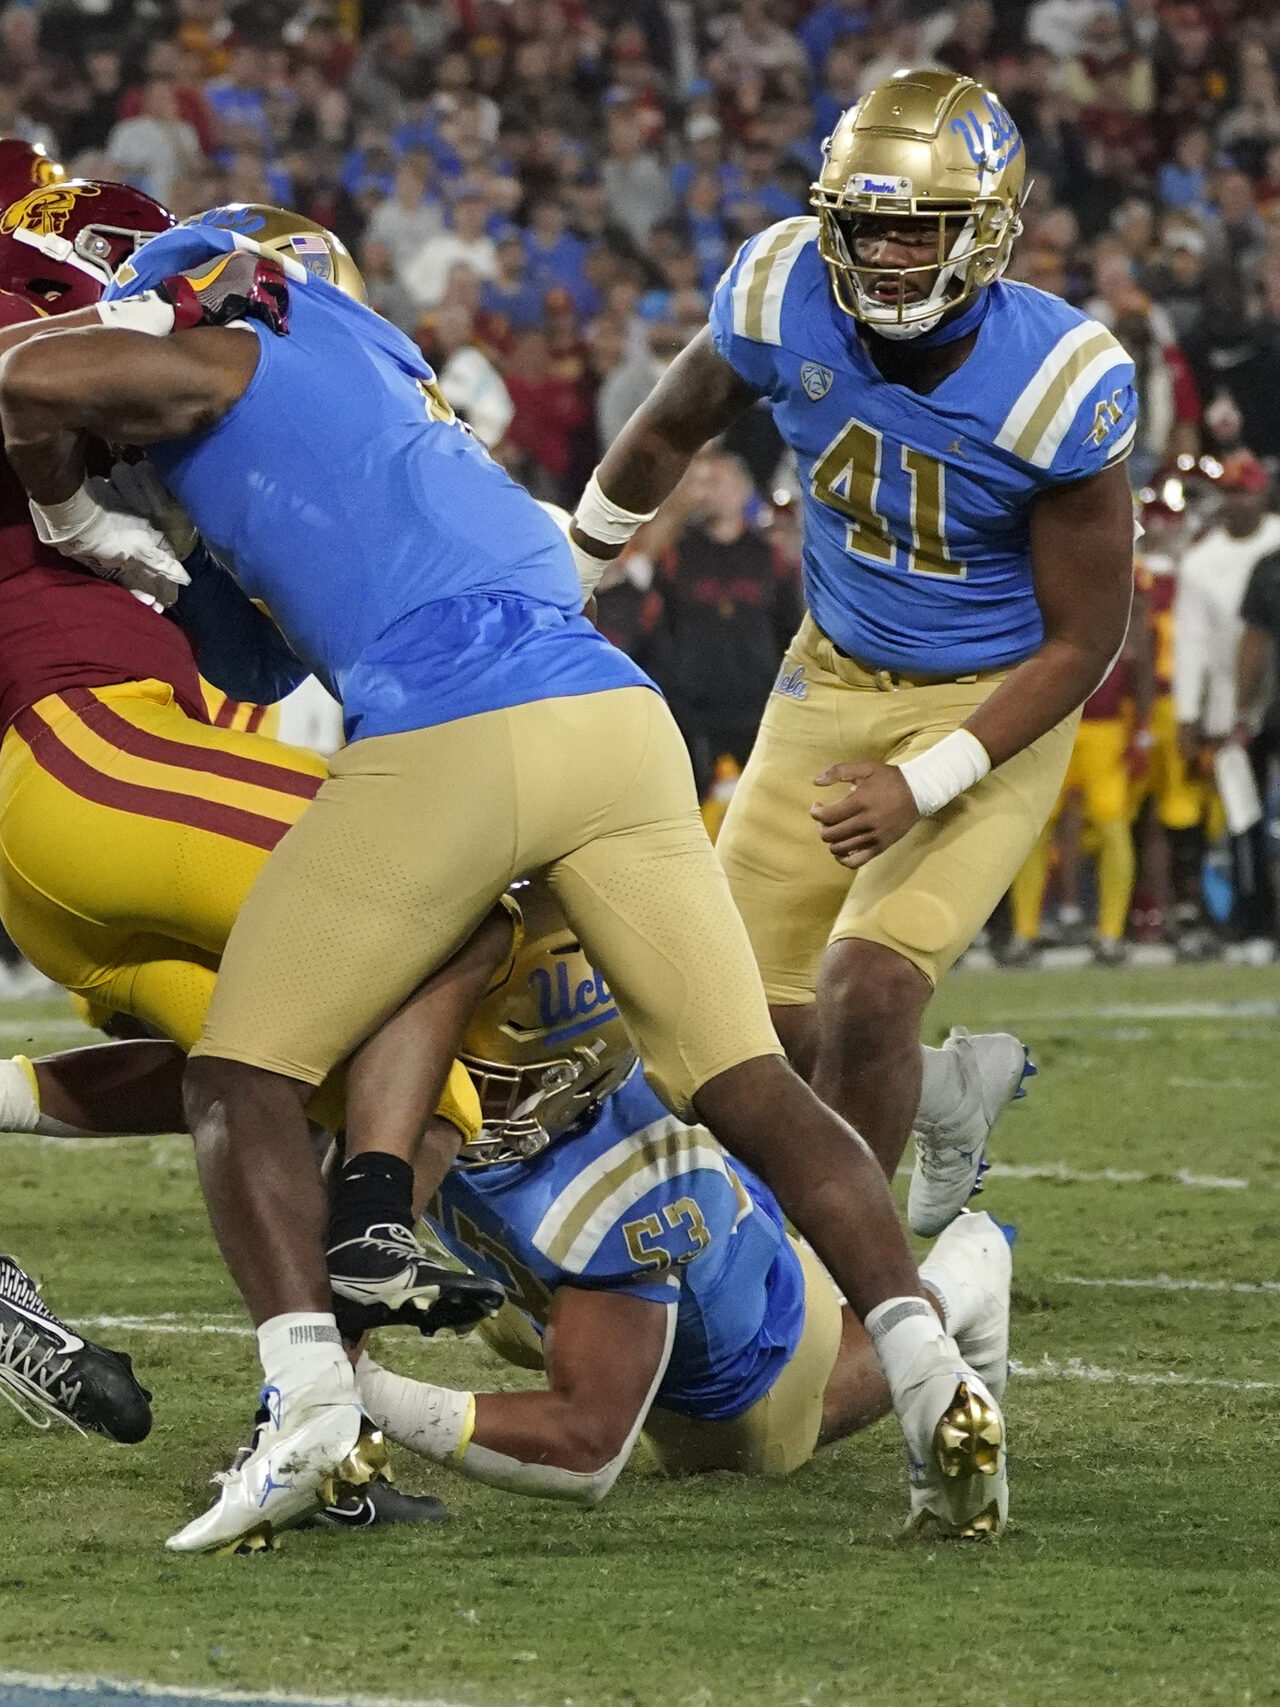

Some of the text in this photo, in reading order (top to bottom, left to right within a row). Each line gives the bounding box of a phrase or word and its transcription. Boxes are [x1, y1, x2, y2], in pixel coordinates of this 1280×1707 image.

[809, 416, 967, 581] 41
[528, 961, 614, 1027] Ucl
[622, 1196, 712, 1271] 53
